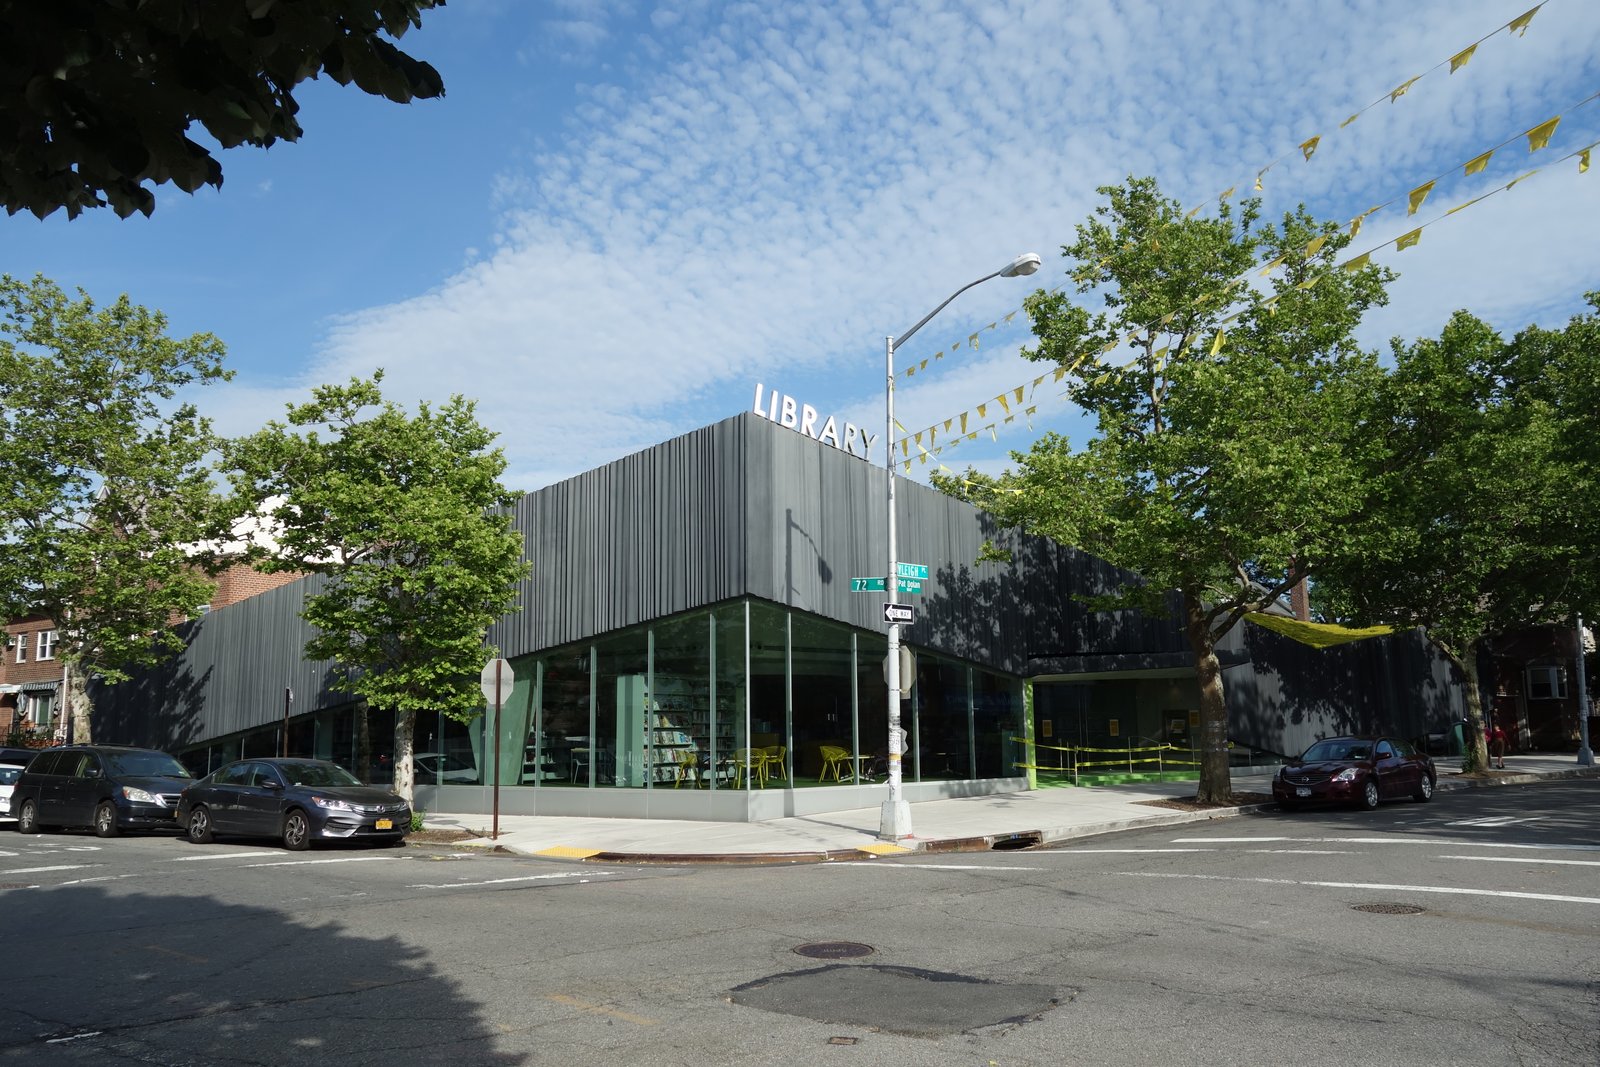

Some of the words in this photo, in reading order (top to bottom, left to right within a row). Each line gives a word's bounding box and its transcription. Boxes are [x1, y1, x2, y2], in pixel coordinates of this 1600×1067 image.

[754, 383, 880, 461] LIBRARY
[855, 580, 867, 591] 72
[898, 579, 907, 588] Pat
[889, 609, 899, 618] ONE
[900, 610, 910, 618] WAY
